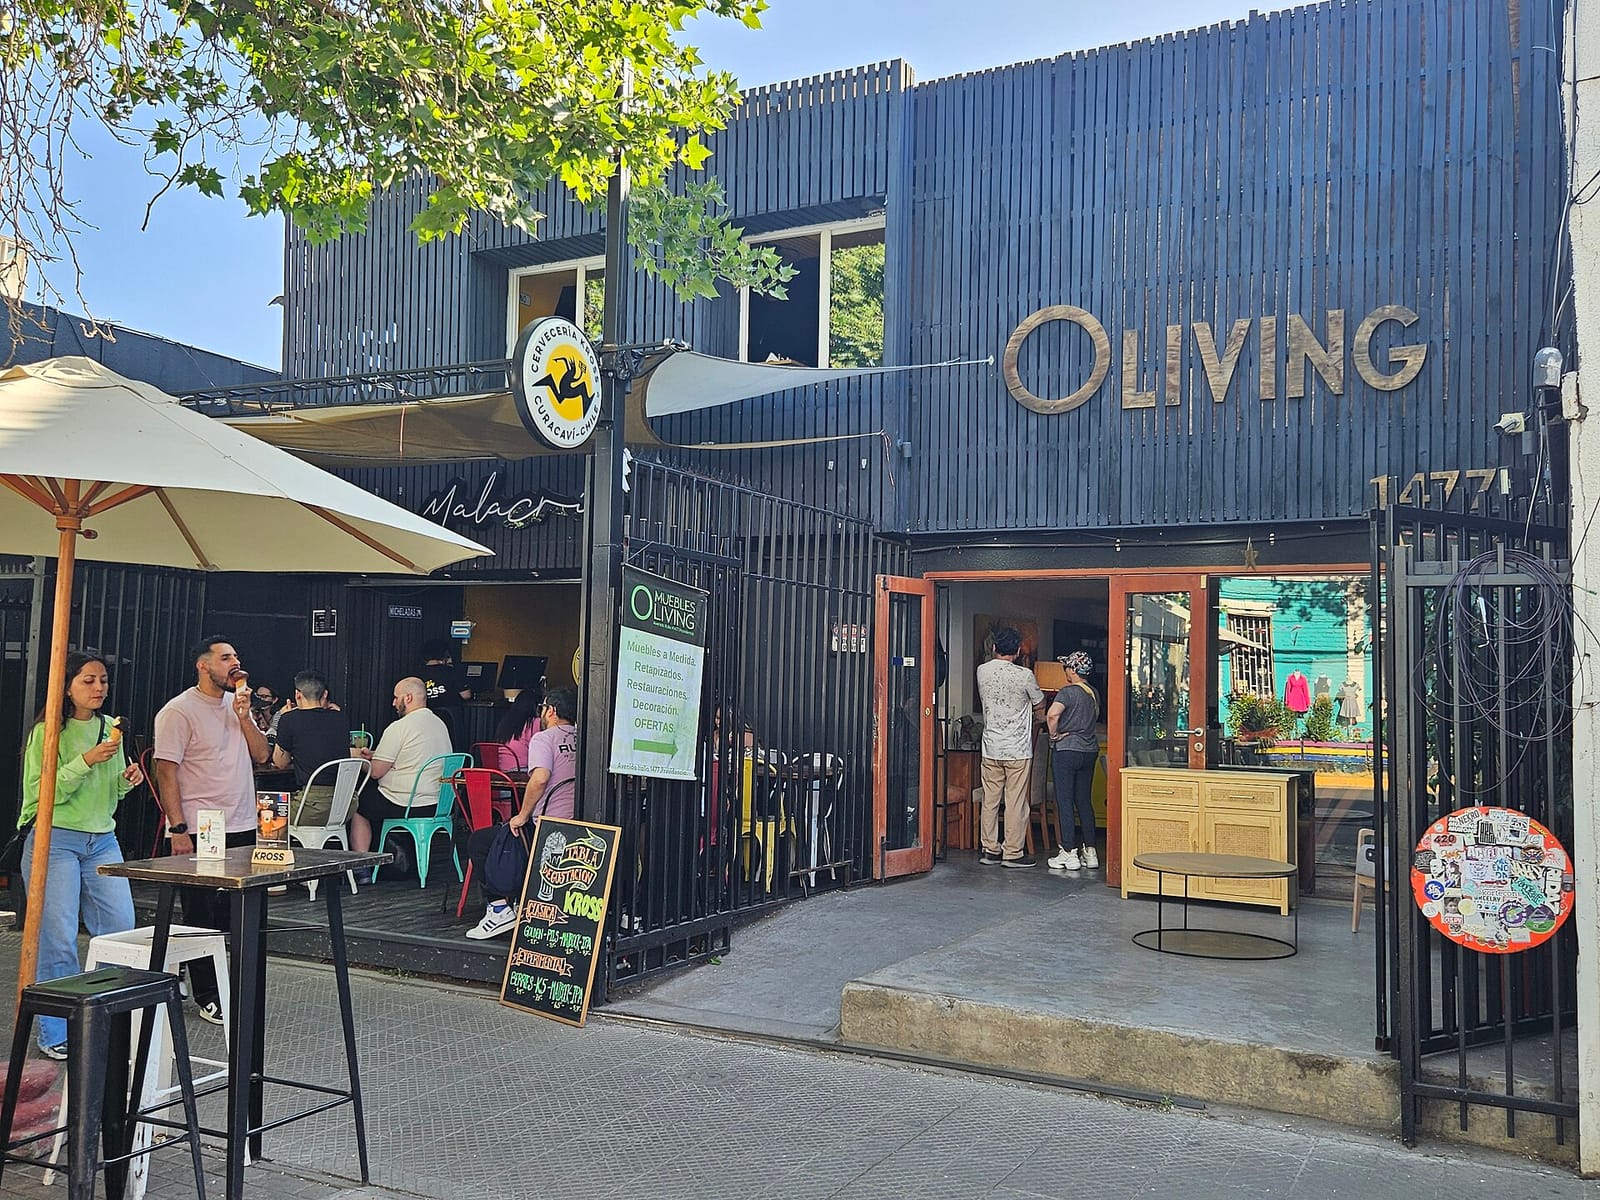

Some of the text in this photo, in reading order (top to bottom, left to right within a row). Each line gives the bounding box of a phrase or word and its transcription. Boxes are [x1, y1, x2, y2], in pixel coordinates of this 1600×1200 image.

[530, 325, 599, 386] CERVECERÍA KROSS
[1003, 304, 1428, 415] OLIVING
[1370, 468, 1497, 510] 1477
[654, 590, 696, 613] MUEBLES
[653, 603, 695, 630] LIVING
[627, 641, 697, 667] Muebles a Medida.
[634, 661, 684, 681] Retapizados.
[627, 678, 688, 701] Restauraciones.
[632, 698, 680, 716] Decoración.
[634, 717, 676, 733] OFERTAS.
[254, 851, 284, 862] KROSS
[565, 845, 598, 867] TABLA
[542, 864, 594, 886] DEGUSTACION
[563, 890, 604, 922] KROSS
